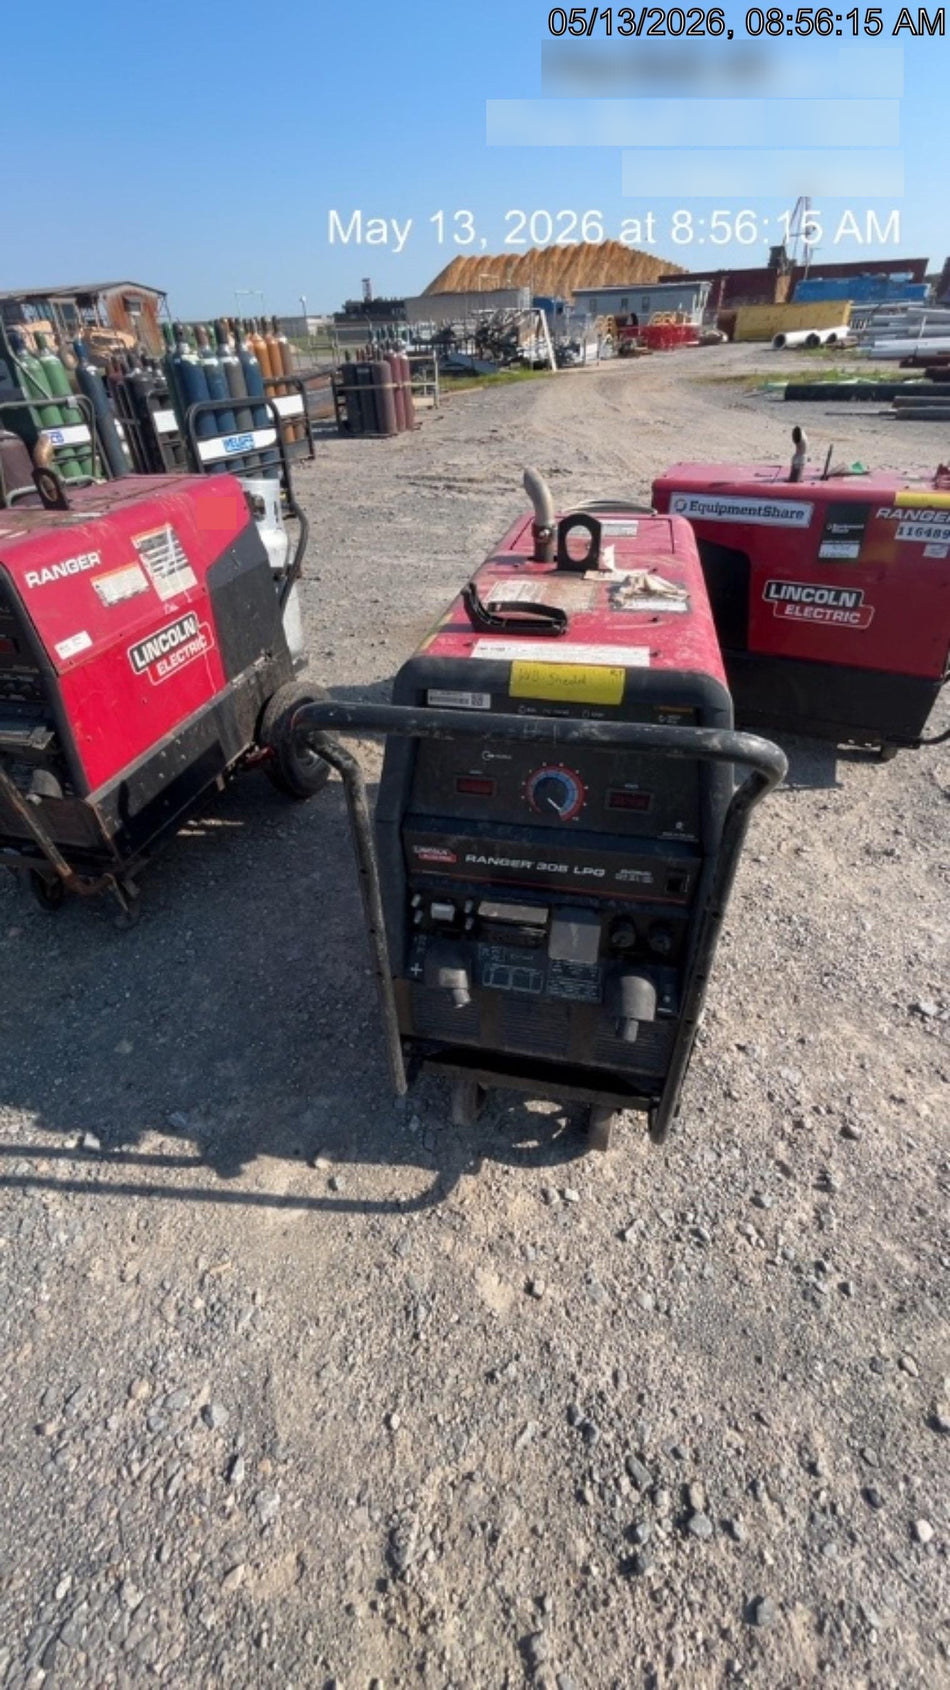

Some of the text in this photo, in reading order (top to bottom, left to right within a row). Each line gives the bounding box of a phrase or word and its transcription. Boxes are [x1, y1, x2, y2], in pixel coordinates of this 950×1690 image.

[688, 500, 805, 520] EquipmentShare
[24, 549, 101, 589] RANGER
[769, 583, 858, 607] LINCOLN
[784, 604, 860, 624] ELECTRIC
[132, 617, 198, 670] LINCOLN
[155, 633, 209, 677] ELECTRIC
[465, 853, 534, 870] RANGER
[573, 865, 606, 878] LPG
